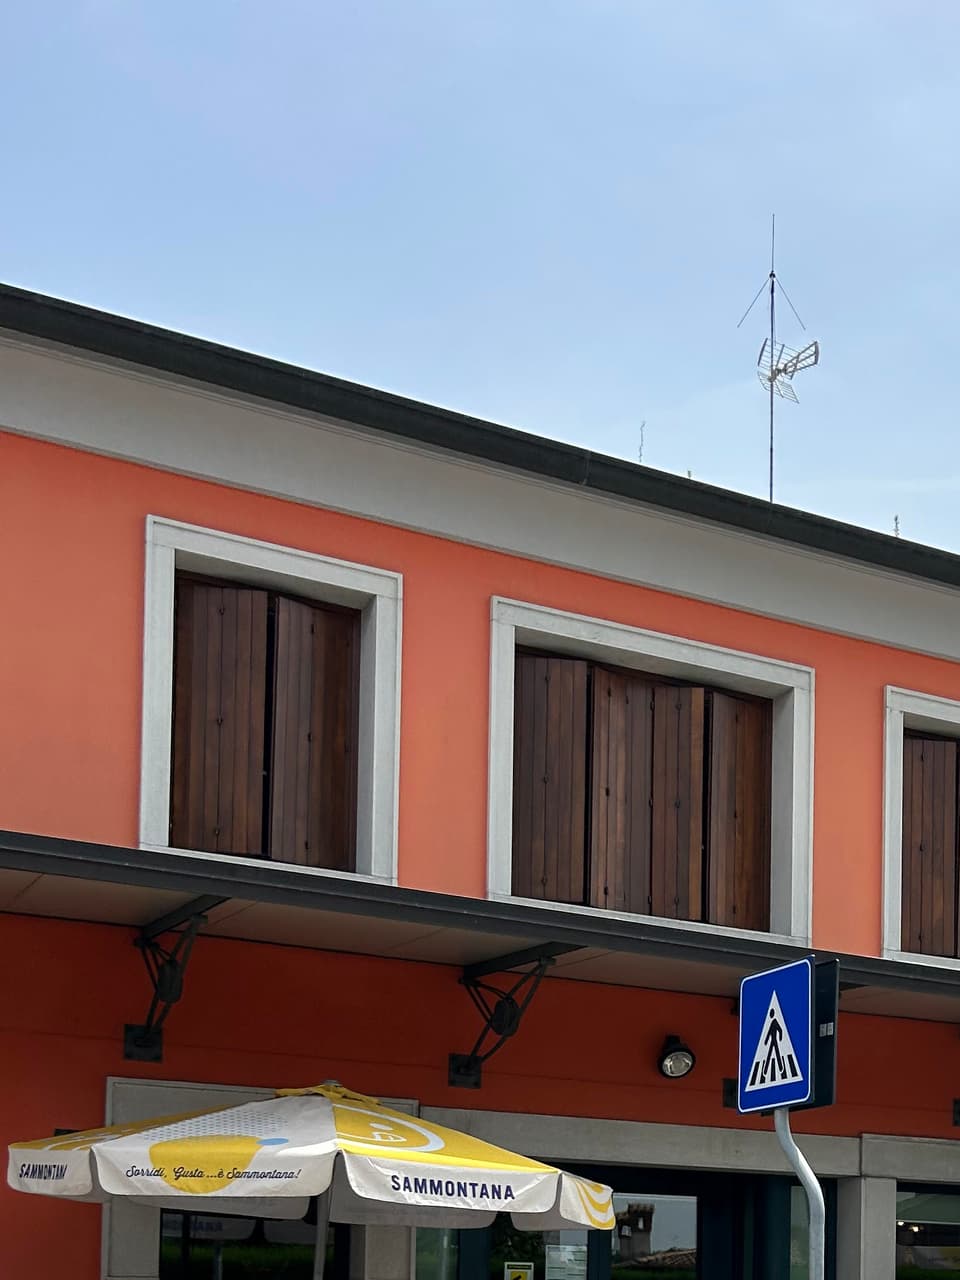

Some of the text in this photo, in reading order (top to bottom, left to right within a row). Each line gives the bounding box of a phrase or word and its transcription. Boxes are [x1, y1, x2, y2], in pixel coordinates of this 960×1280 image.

[125, 1165, 168, 1178] Sorridi,
[172, 1166, 205, 1179] Gusta
[227, 1167, 302, 1179] Sammontana!
[391, 1174, 516, 1200] SAMMONTANA
